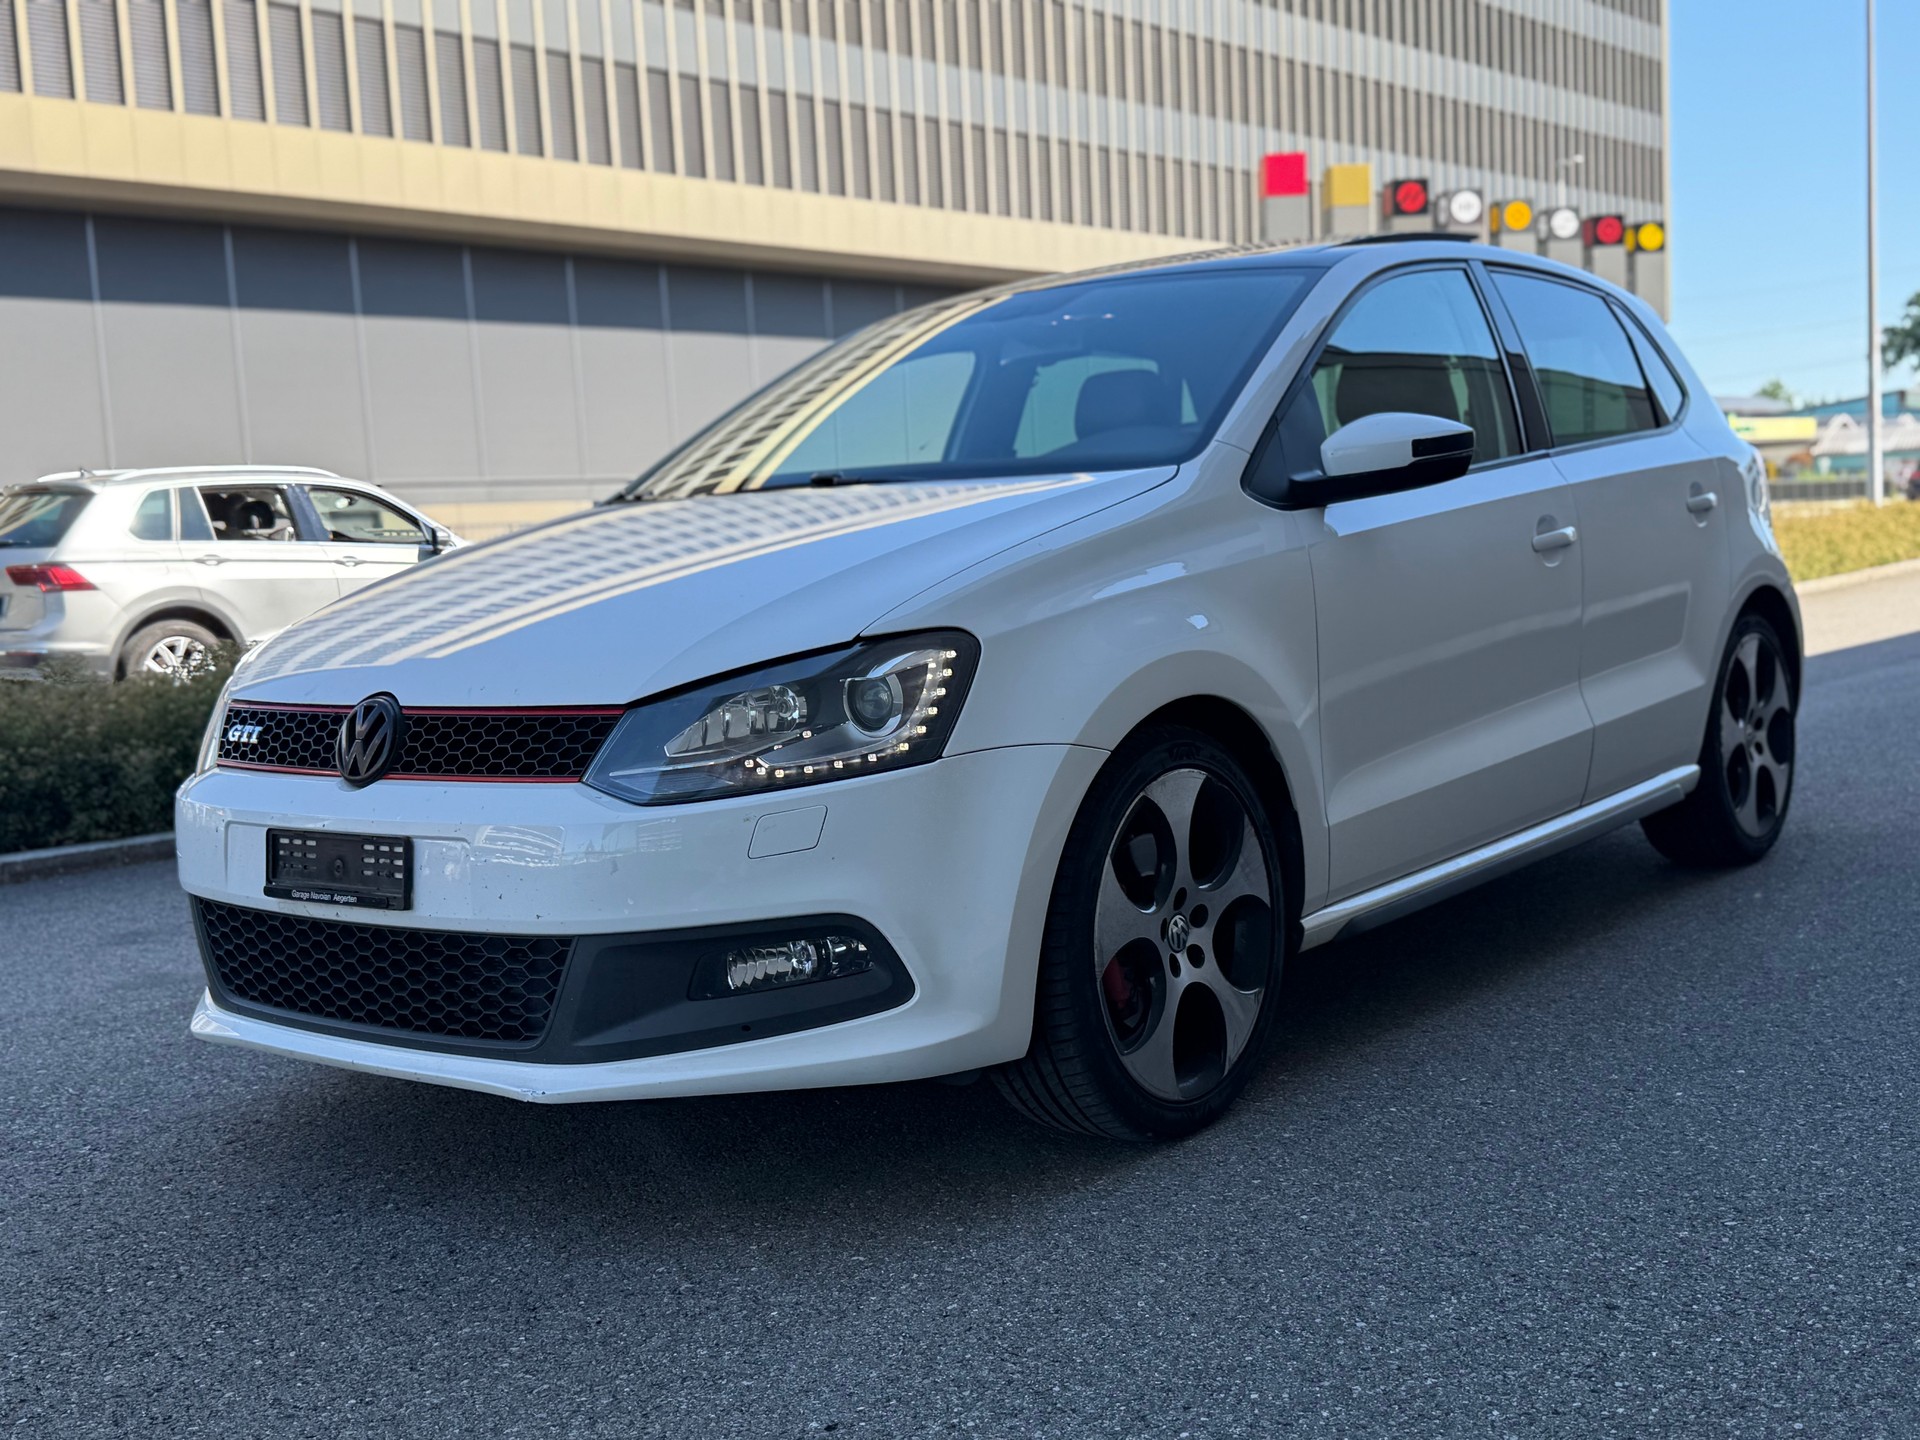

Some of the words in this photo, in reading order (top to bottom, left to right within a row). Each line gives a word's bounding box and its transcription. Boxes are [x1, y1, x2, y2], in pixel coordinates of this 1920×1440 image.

[228, 724, 263, 744] GTI
[291, 889, 310, 900] Garage
[332, 893, 358, 904] Aegerten
